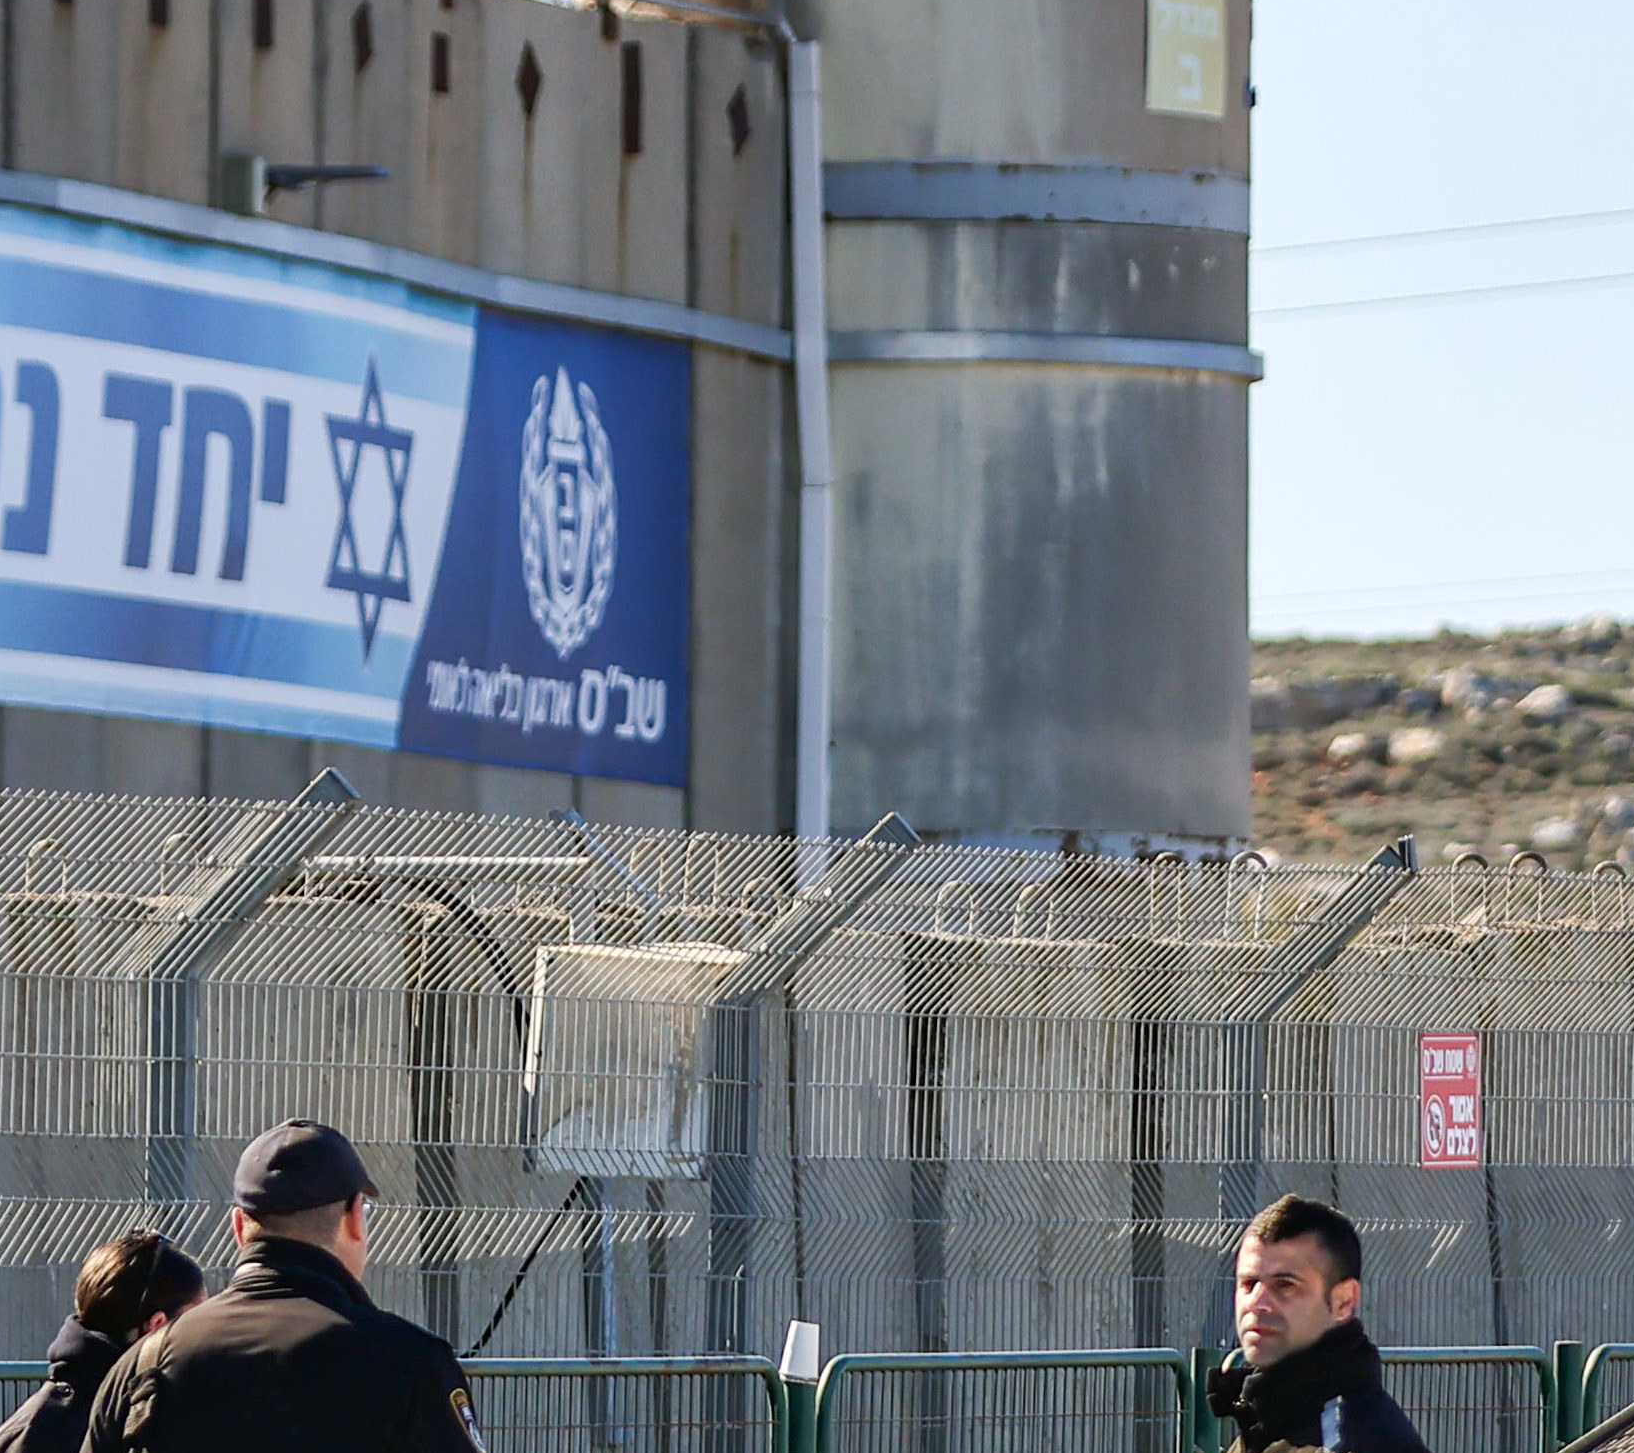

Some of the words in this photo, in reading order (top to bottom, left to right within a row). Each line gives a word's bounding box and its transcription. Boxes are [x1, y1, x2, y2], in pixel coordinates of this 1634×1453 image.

[102, 371, 290, 582] יחד
[1448, 1095, 1475, 1122] אסור
[1446, 1125, 1477, 1155] לצלם
